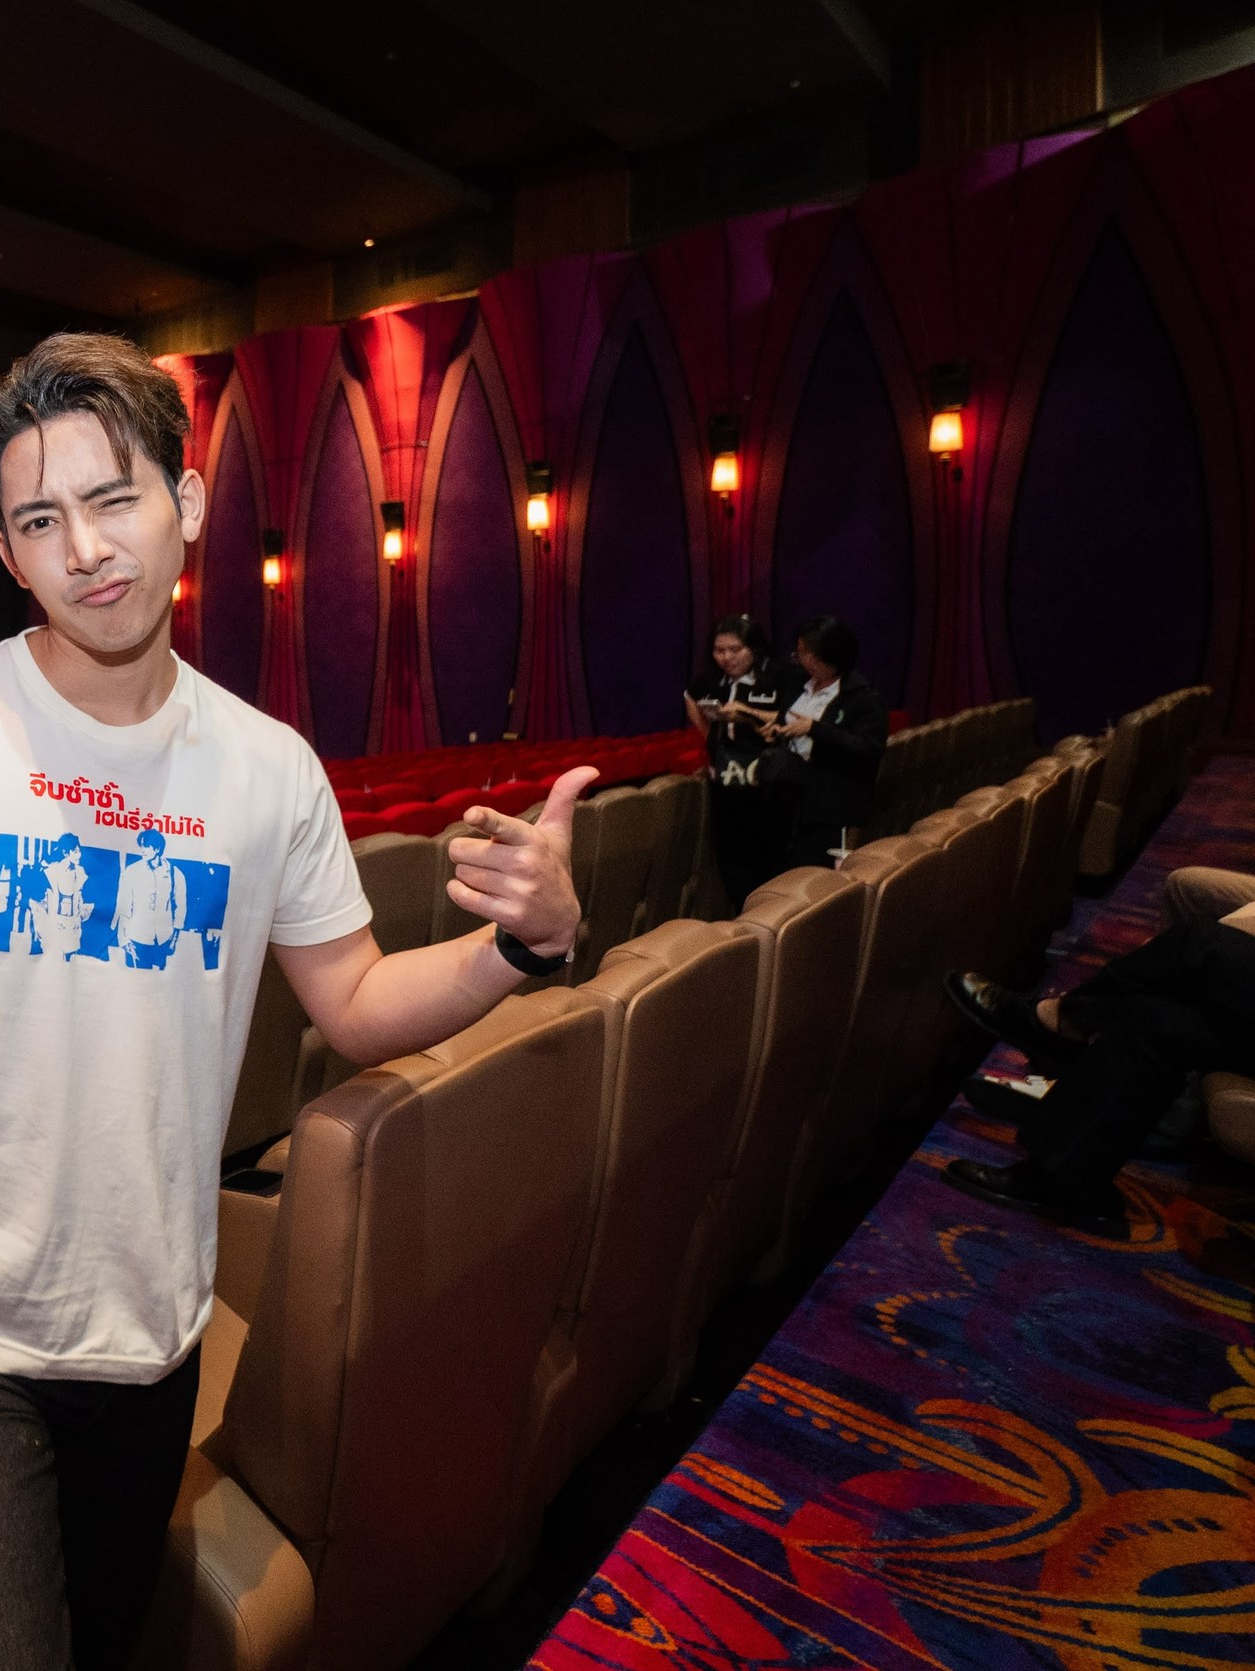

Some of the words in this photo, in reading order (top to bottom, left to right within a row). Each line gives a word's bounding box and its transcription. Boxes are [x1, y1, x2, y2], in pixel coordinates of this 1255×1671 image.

[29, 772, 125, 811] จีบซ้ำซ้ำ
[95, 808, 206, 838] เฮนรี่จำไม่ได้
